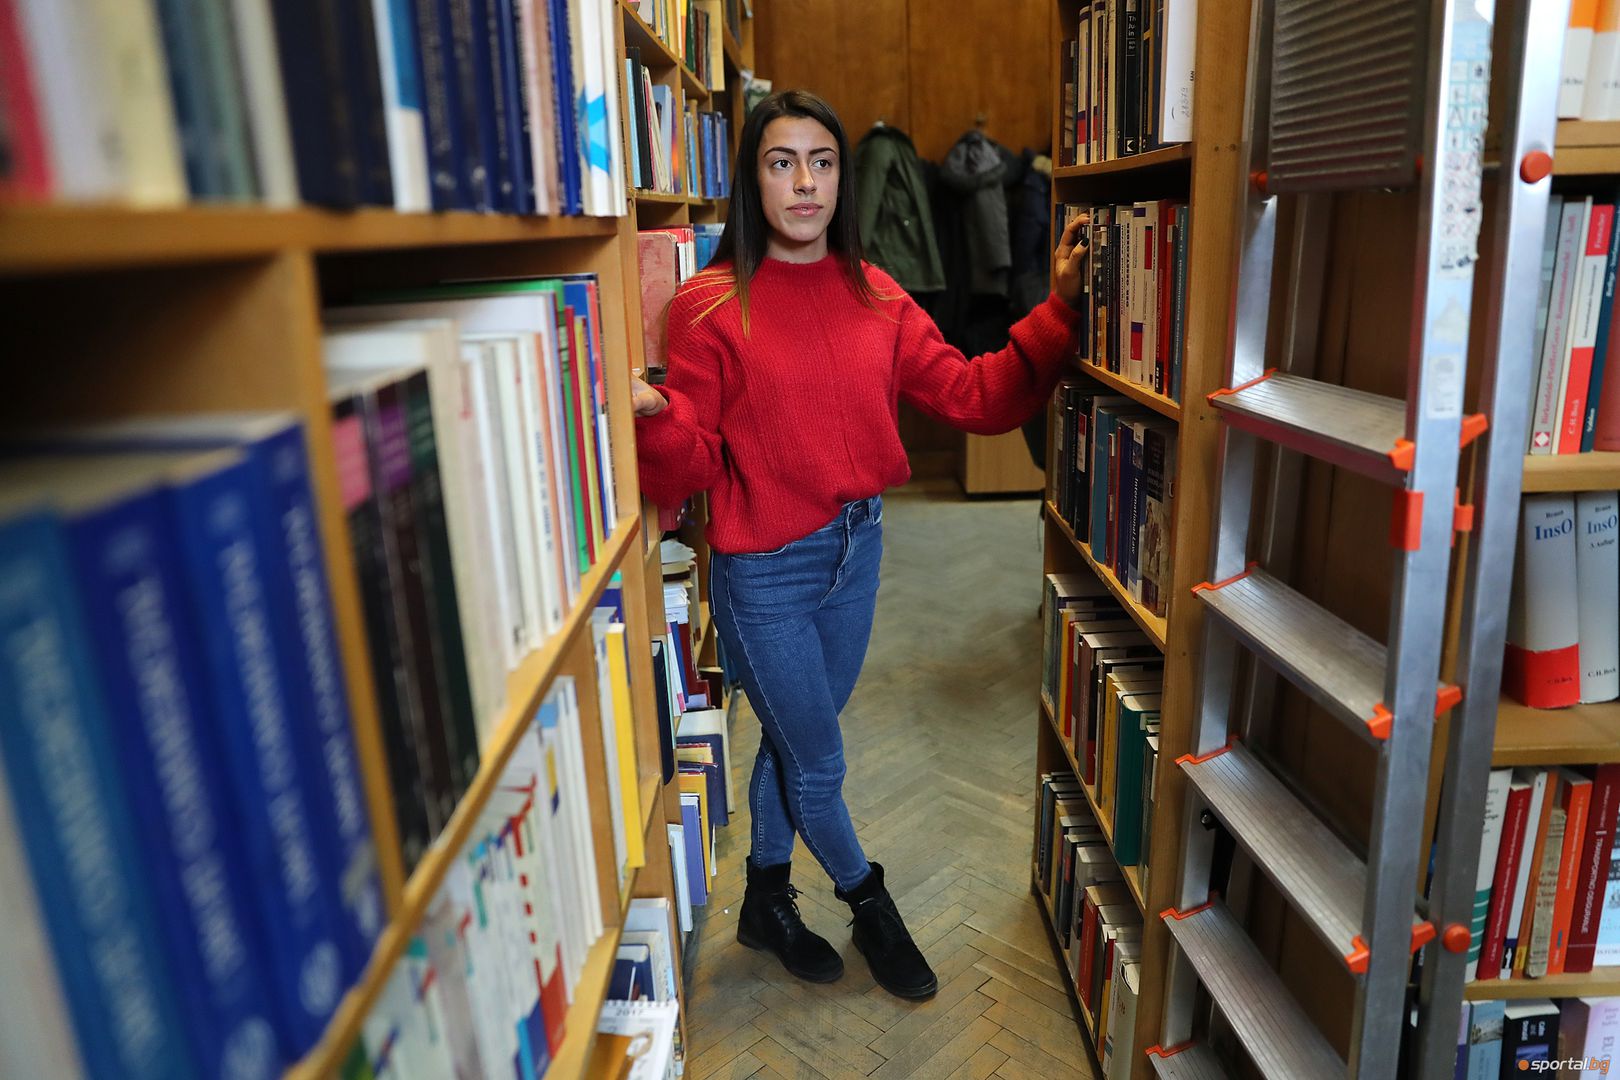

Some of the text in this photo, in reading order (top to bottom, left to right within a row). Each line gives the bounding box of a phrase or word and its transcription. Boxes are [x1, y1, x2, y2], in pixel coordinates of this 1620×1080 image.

[1535, 518, 1573, 541] InsO
[1587, 514, 1618, 535] InsO
[615, 1008, 644, 1017] 2017
